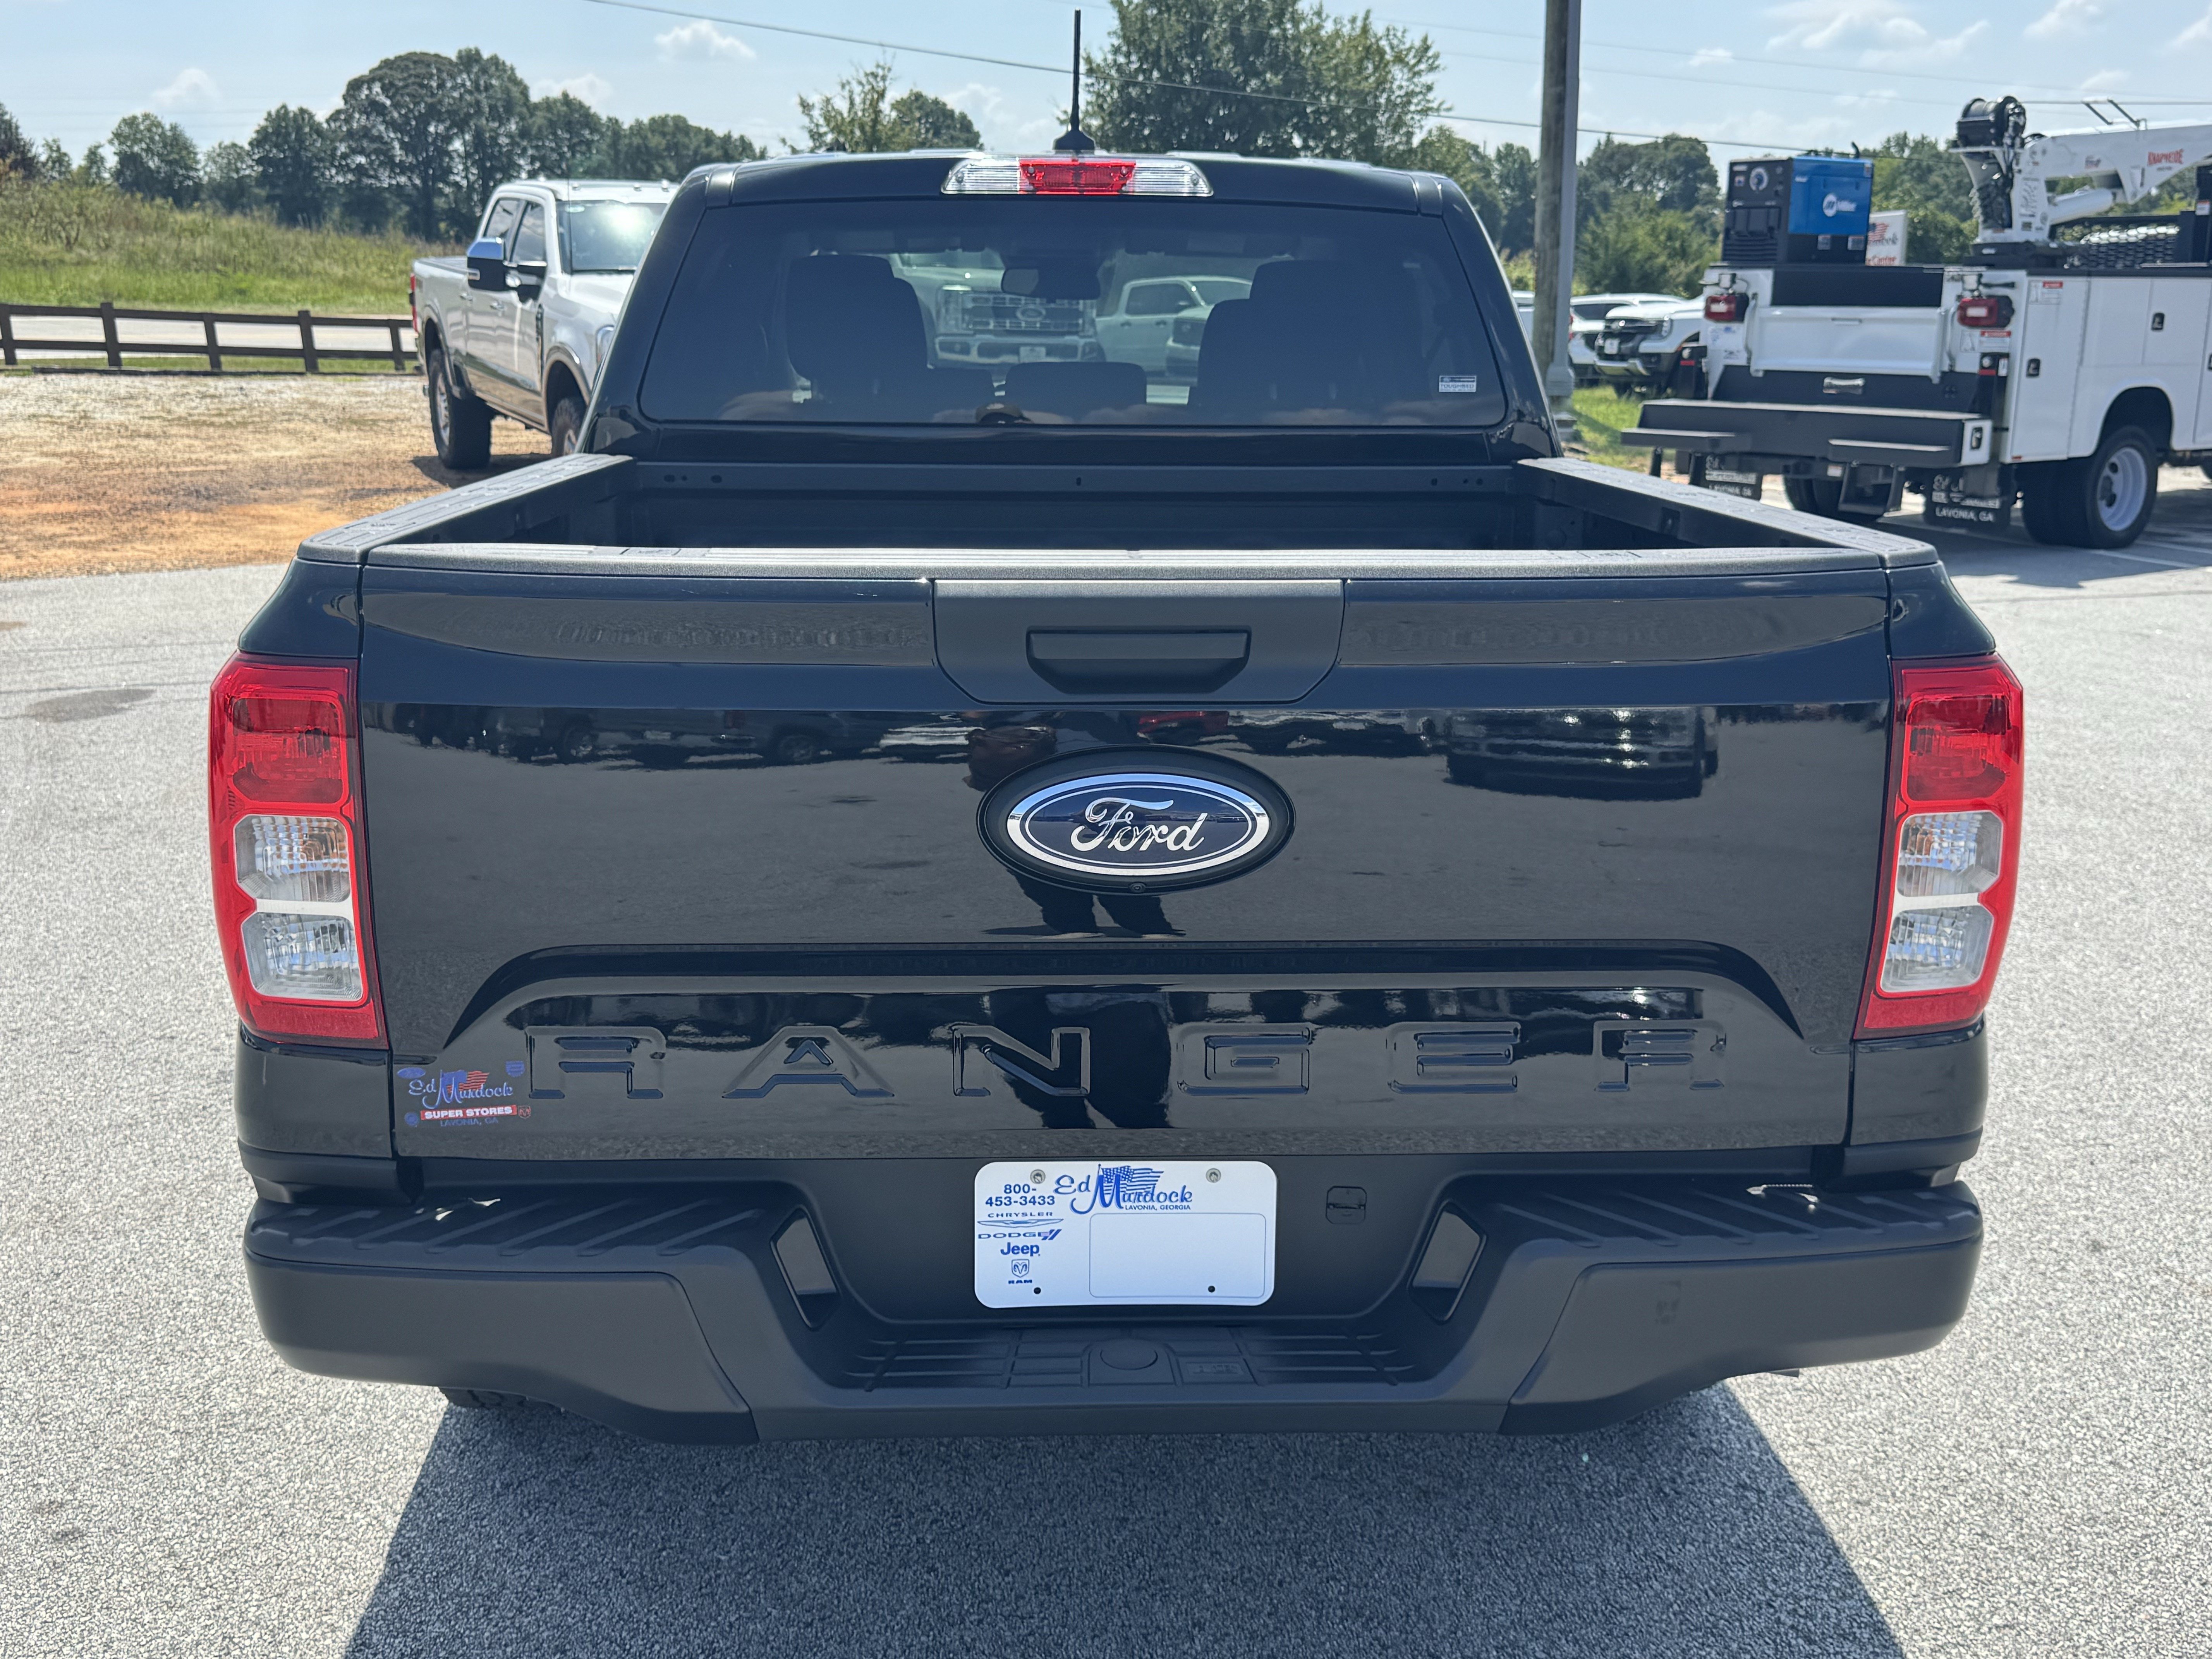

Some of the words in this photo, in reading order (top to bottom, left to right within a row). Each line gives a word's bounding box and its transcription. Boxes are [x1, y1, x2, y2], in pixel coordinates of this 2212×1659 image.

[1979, 511, 1994, 521] GA
[1071, 798, 1208, 852] Ford
[525, 1020, 1727, 1099] RANGER
[409, 1079, 436, 1096] Ed
[422, 1076, 514, 1109] Murdock
[424, 1109, 464, 1119] SUPER
[466, 1106, 512, 1117] STORES
[1004, 1184, 1036, 1194] 800-
[1053, 1175, 1091, 1195] Ed
[1070, 1173, 1193, 1214] Murdock
[985, 1195, 1055, 1207] 453-3433
[1000, 1242, 1040, 1257] Jeep
